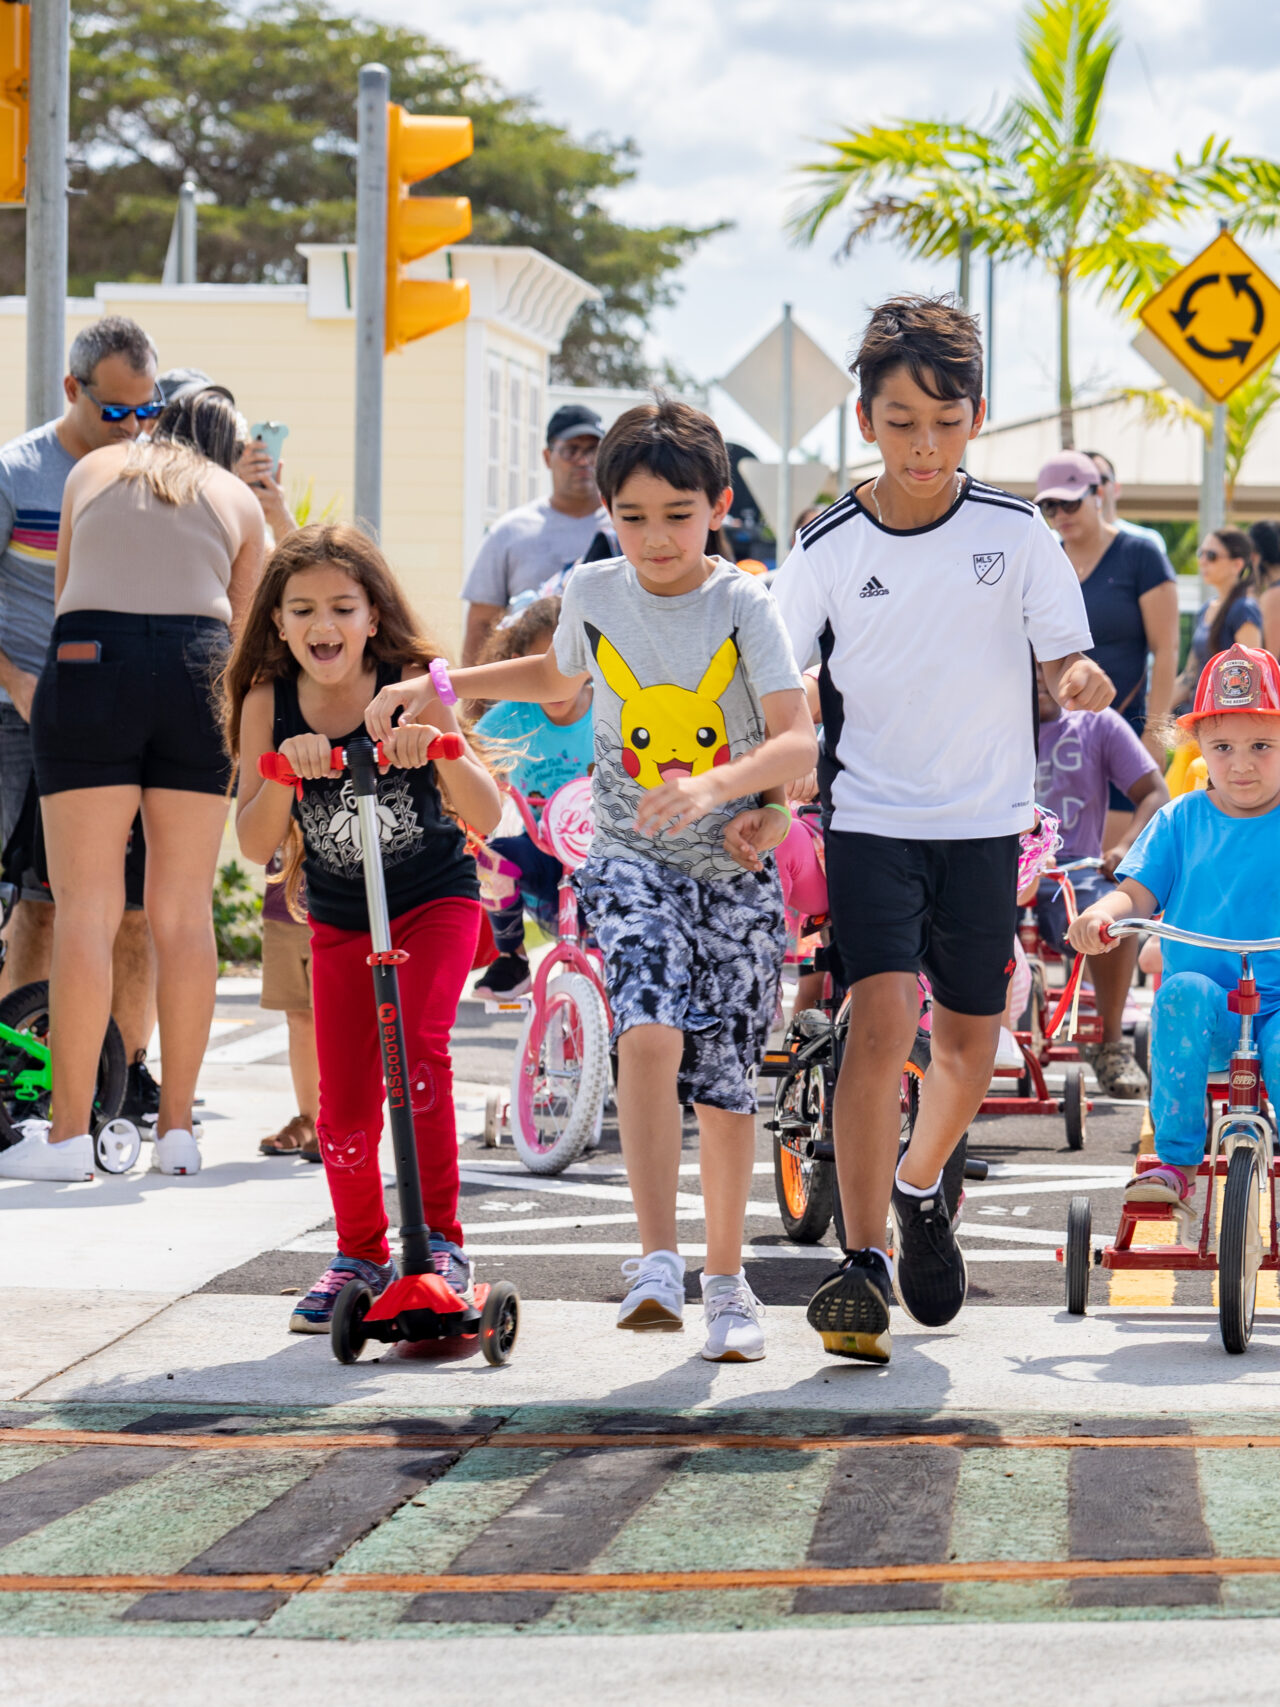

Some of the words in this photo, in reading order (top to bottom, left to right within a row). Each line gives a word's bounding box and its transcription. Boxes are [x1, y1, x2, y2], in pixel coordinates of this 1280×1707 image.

[975, 555, 993, 564] MLS
[859, 587, 890, 599] adidas
[383, 1025, 405, 1109] LaScoota
